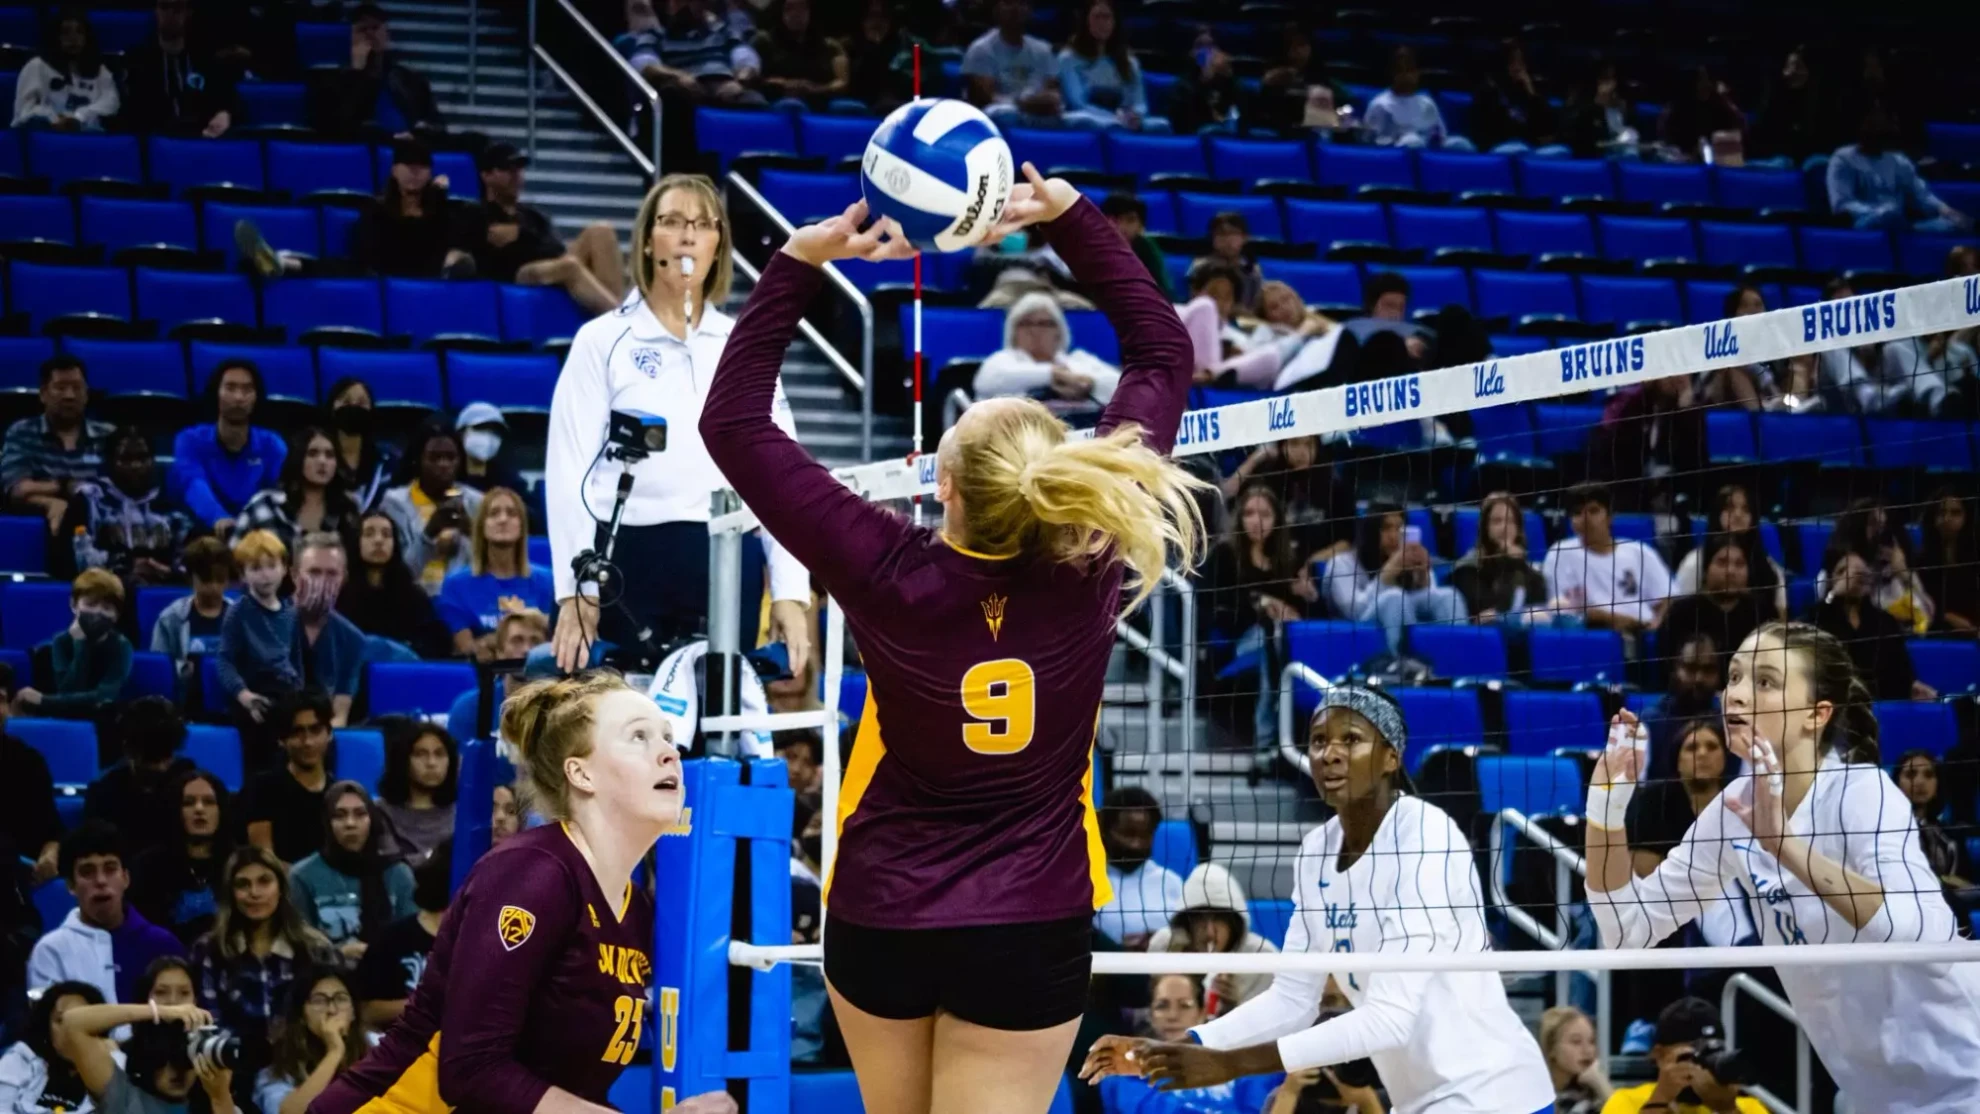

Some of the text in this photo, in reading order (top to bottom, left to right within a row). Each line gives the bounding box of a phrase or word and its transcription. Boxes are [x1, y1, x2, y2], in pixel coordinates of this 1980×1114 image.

[952, 173, 990, 238] Wilson
[1802, 292, 1897, 343] BRUINS
[1963, 277, 1980, 316] U
[1560, 337, 1645, 383] BRUINS
[1345, 376, 1421, 418] BRUINS
[1174, 411, 1221, 446] UINS
[919, 457, 938, 485] Ucl
[960, 658, 1036, 755] 9
